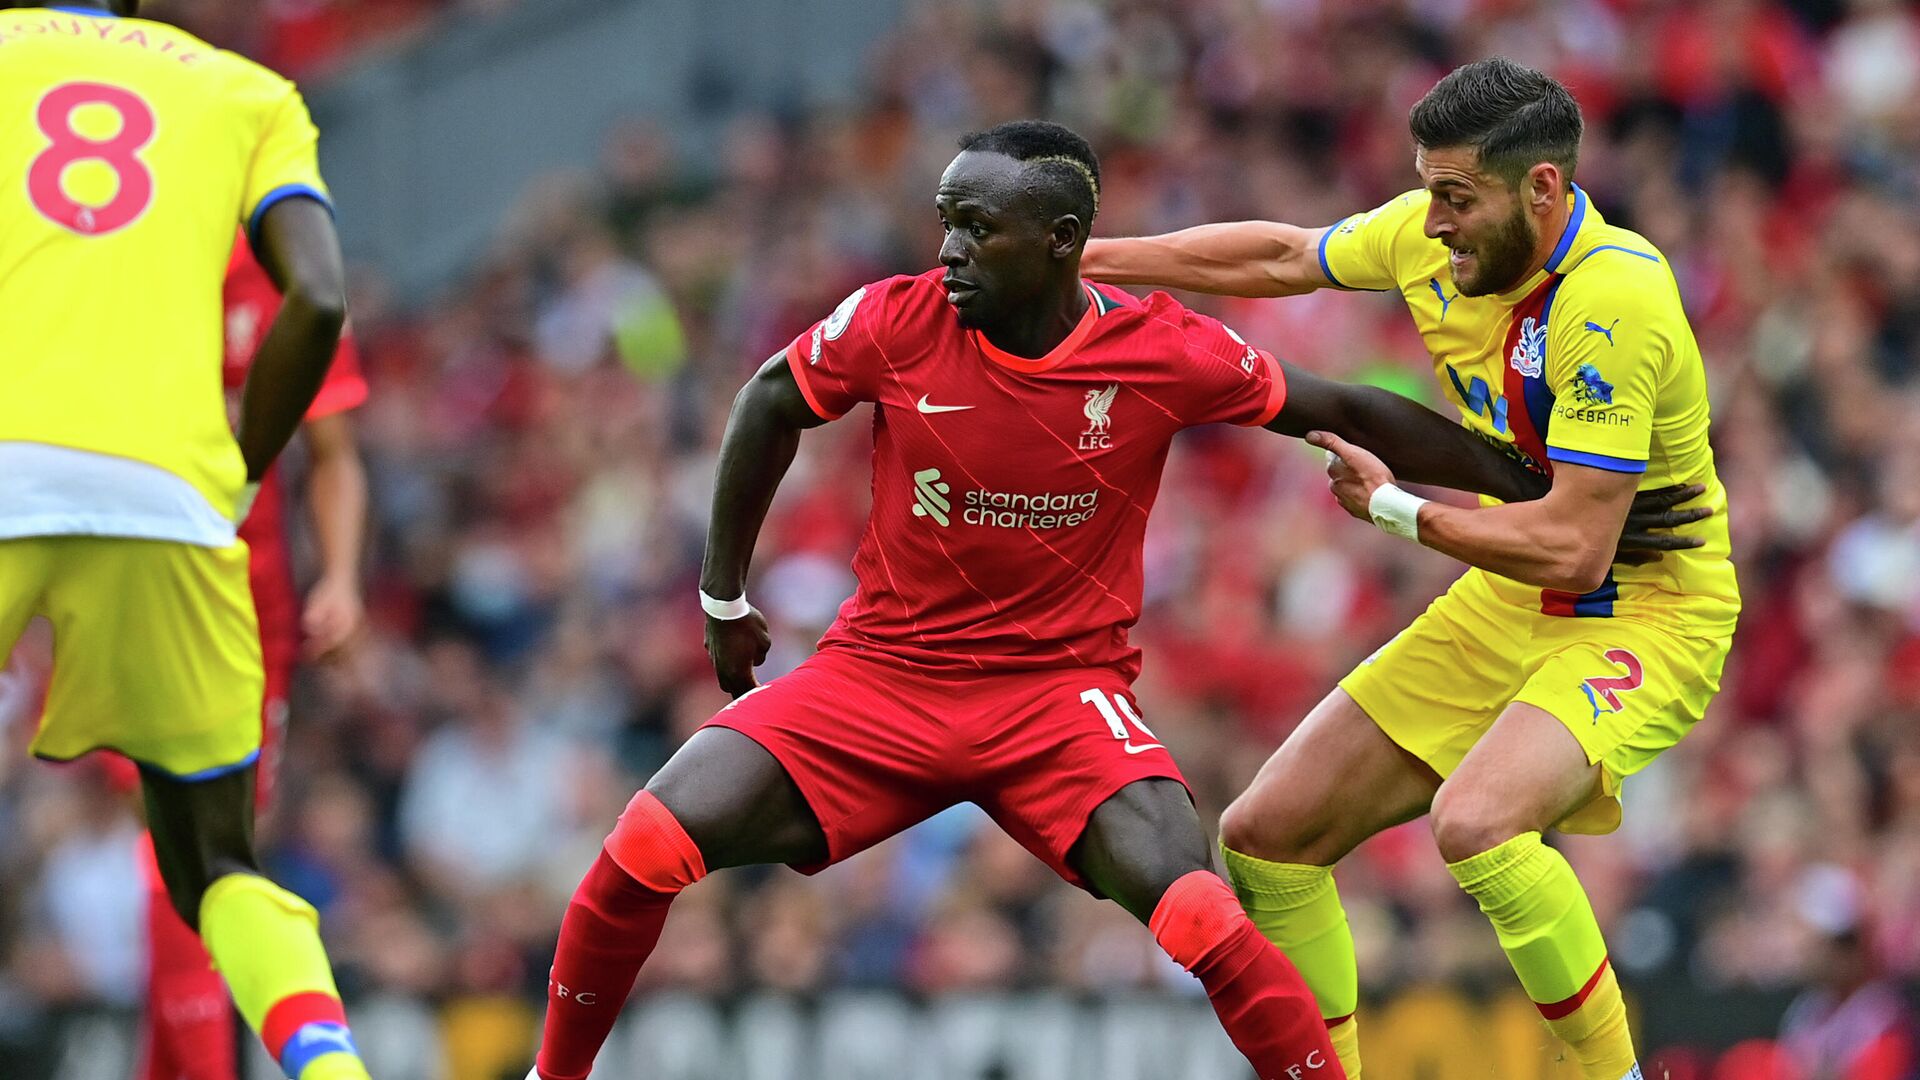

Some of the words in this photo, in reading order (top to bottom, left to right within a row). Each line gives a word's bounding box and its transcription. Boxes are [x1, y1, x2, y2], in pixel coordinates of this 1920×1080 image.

[28, 81, 155, 236] 8
[963, 504, 1099, 529] chartered
[964, 489, 1099, 511] standard
[1583, 648, 1643, 713] 2
